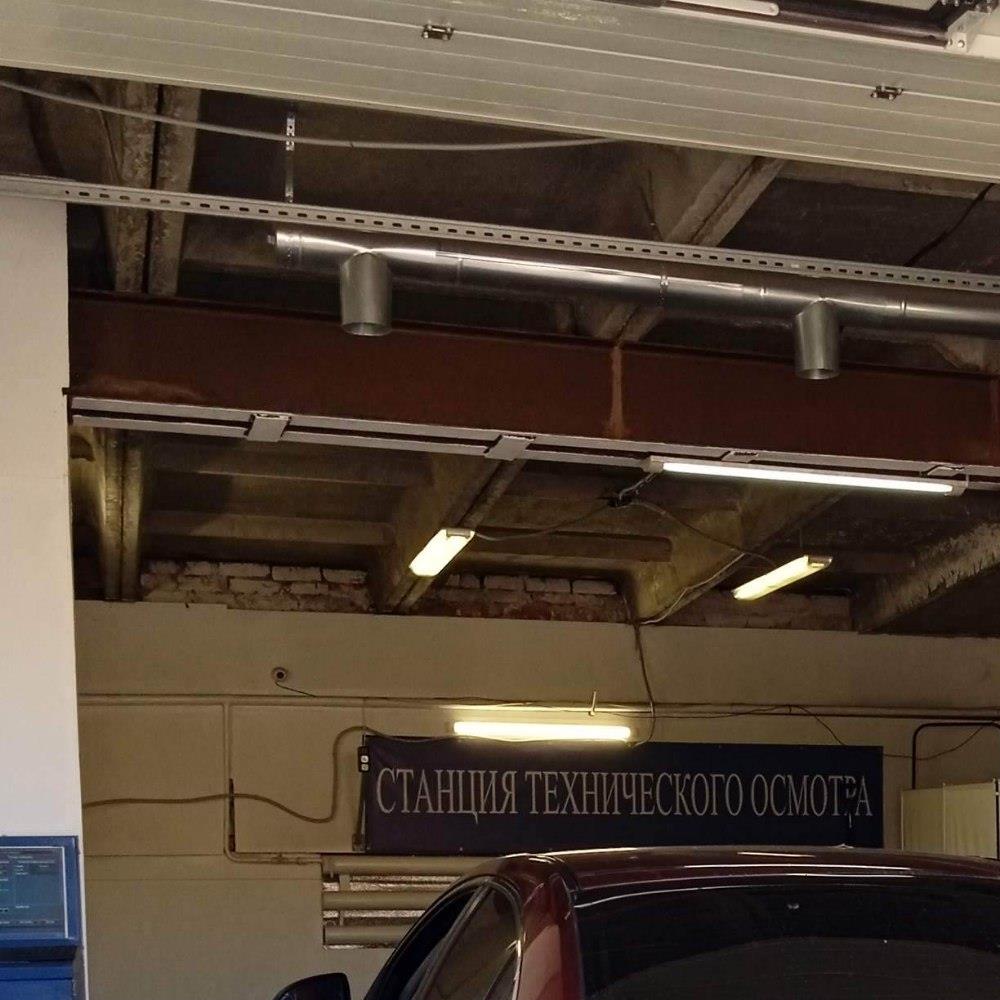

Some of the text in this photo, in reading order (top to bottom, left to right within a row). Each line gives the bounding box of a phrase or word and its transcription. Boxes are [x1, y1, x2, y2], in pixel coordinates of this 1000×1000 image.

[376, 767, 873, 824] СТАНЦИЯ ТЕХНИЧЕСКОГО ОСМОТРА
